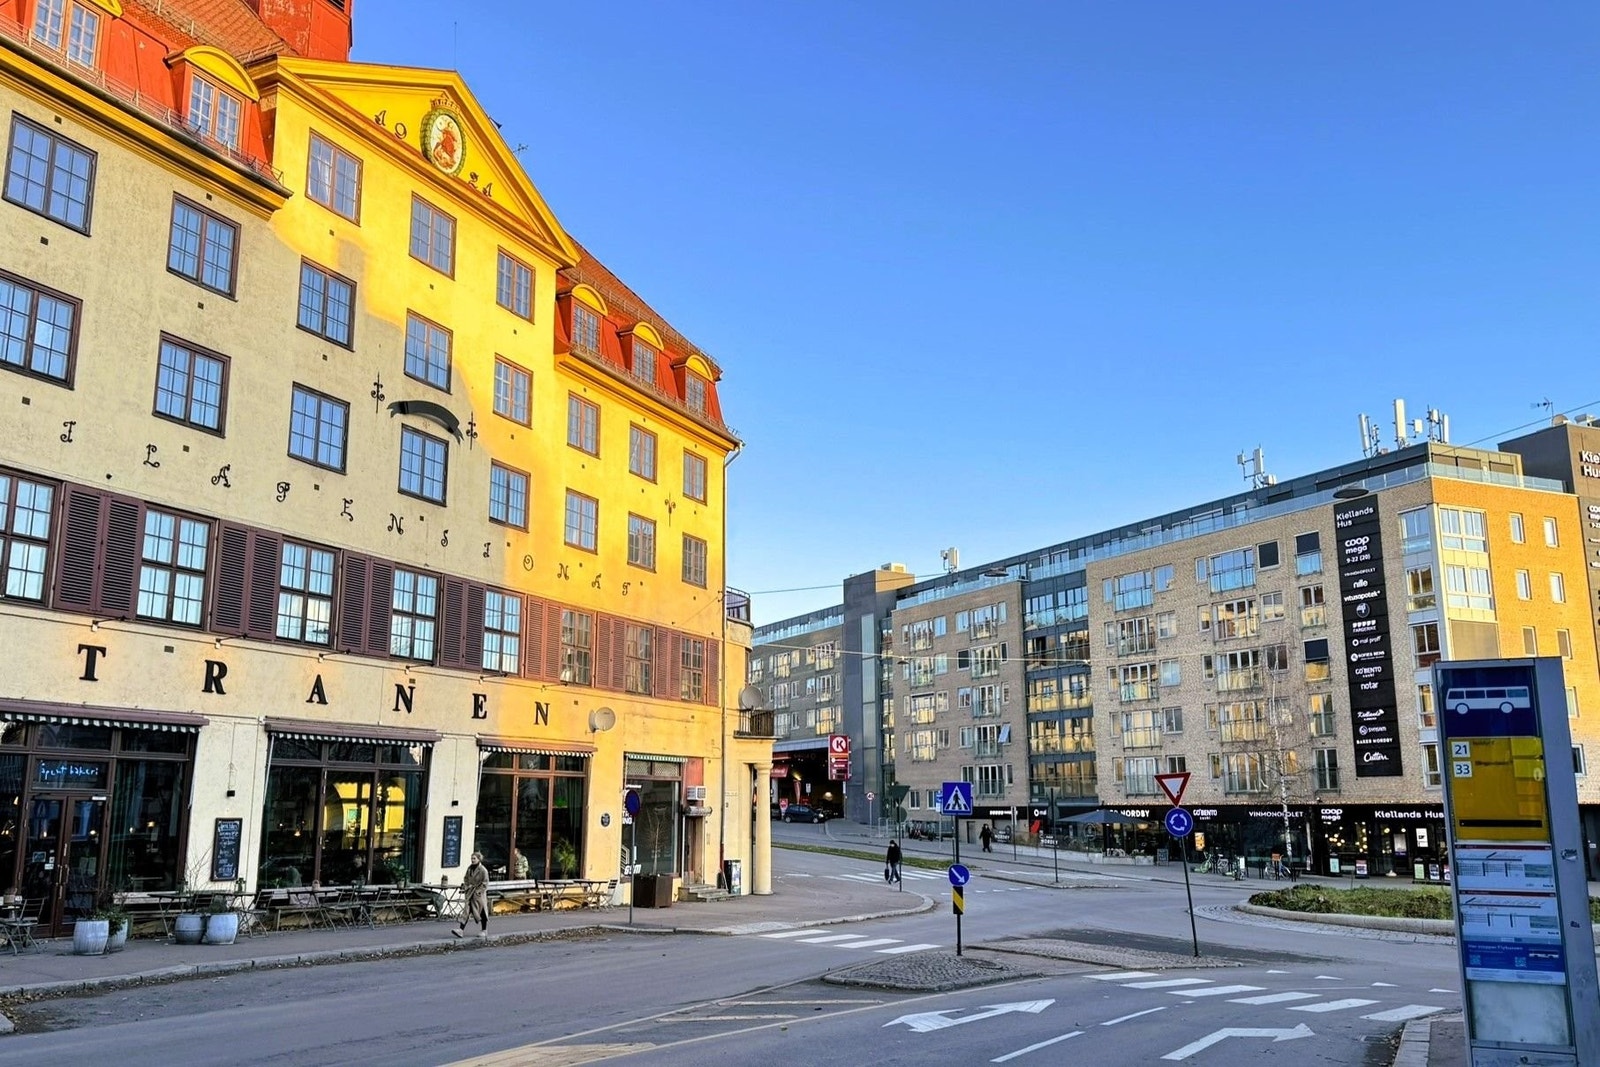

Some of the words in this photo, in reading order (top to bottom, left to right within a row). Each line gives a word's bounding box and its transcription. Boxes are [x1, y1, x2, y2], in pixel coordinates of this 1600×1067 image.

[1336, 507, 1374, 521] Kiellands
[1337, 520, 1352, 528] Hus
[1345, 536, 1369, 547] coop
[1345, 545, 1368, 555] mega
[77, 643, 550, 726] TRANEN
[1360, 681, 1379, 690] notar
[1454, 744, 1468, 755] 21
[1456, 764, 1471, 775] 33
[1120, 809, 1150, 818] NORDBY
[1321, 808, 1343, 816] coop
[1374, 810, 1422, 819] Kiellands
[1425, 811, 1445, 819] Hus
